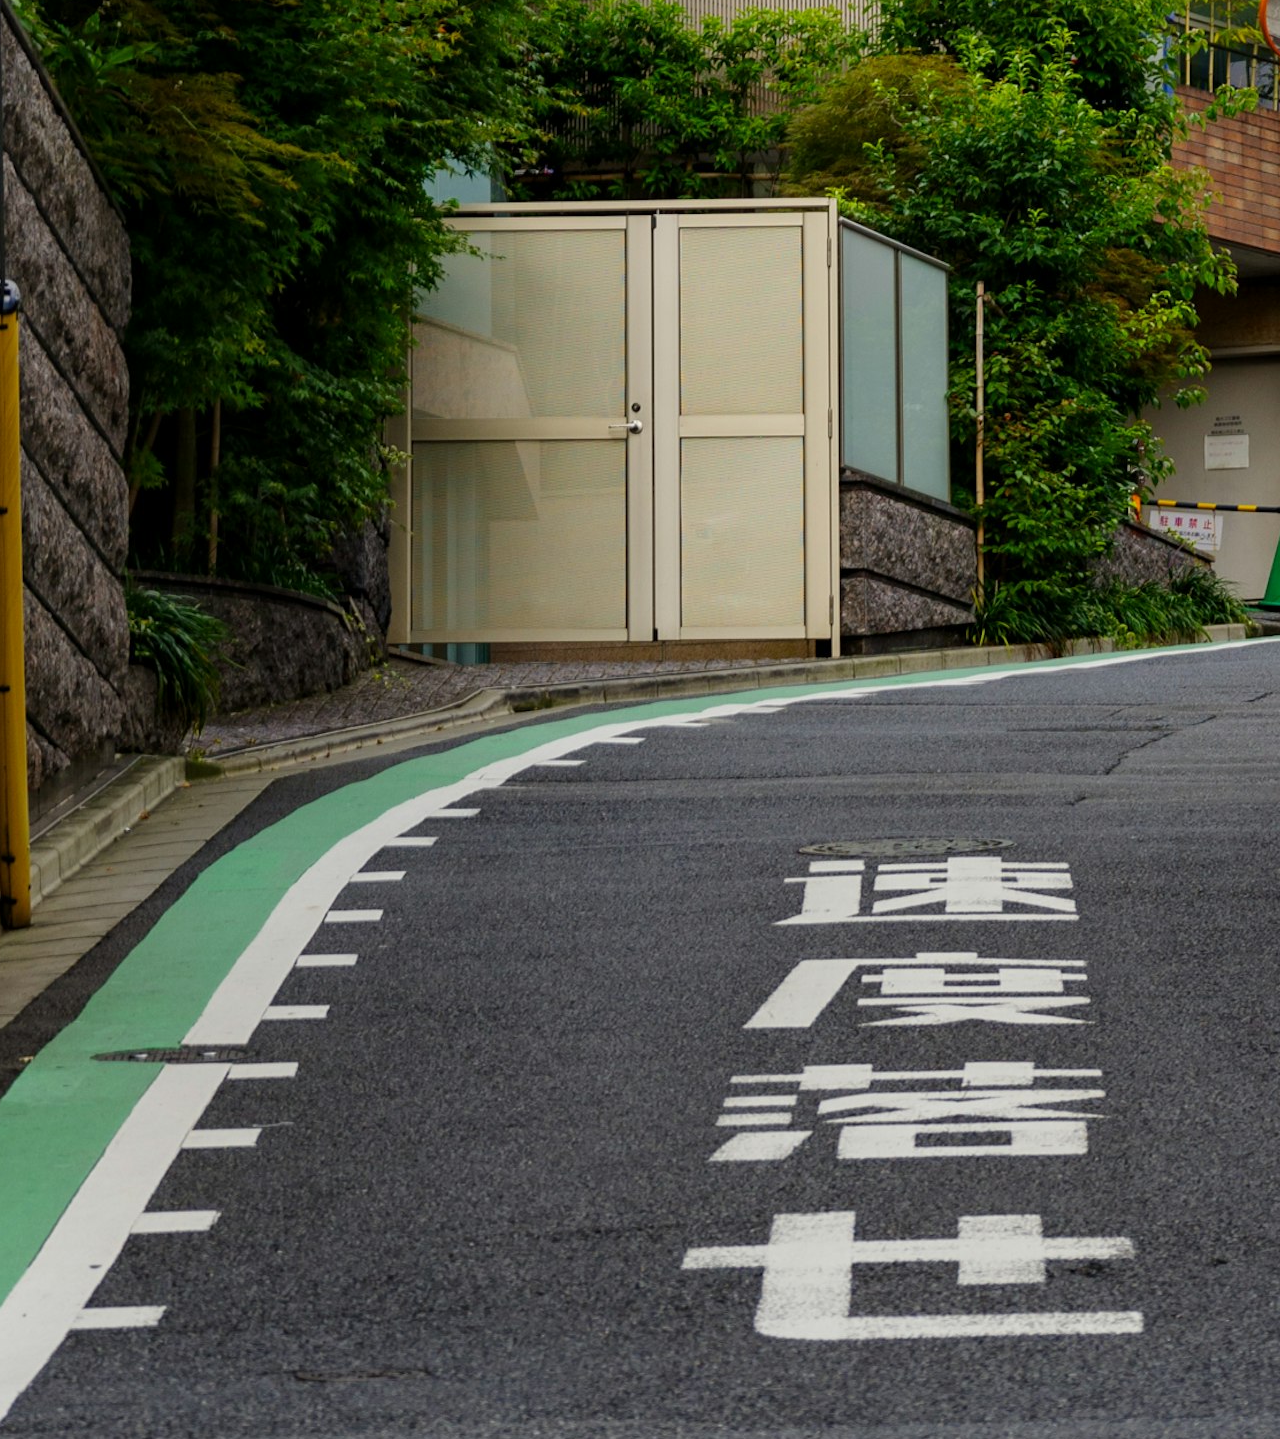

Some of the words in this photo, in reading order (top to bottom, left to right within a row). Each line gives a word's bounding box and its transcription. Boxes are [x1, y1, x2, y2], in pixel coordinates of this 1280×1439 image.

[1159, 515, 1212, 530] 駐車禁止
[681, 856, 1143, 1340] 速度落せ
